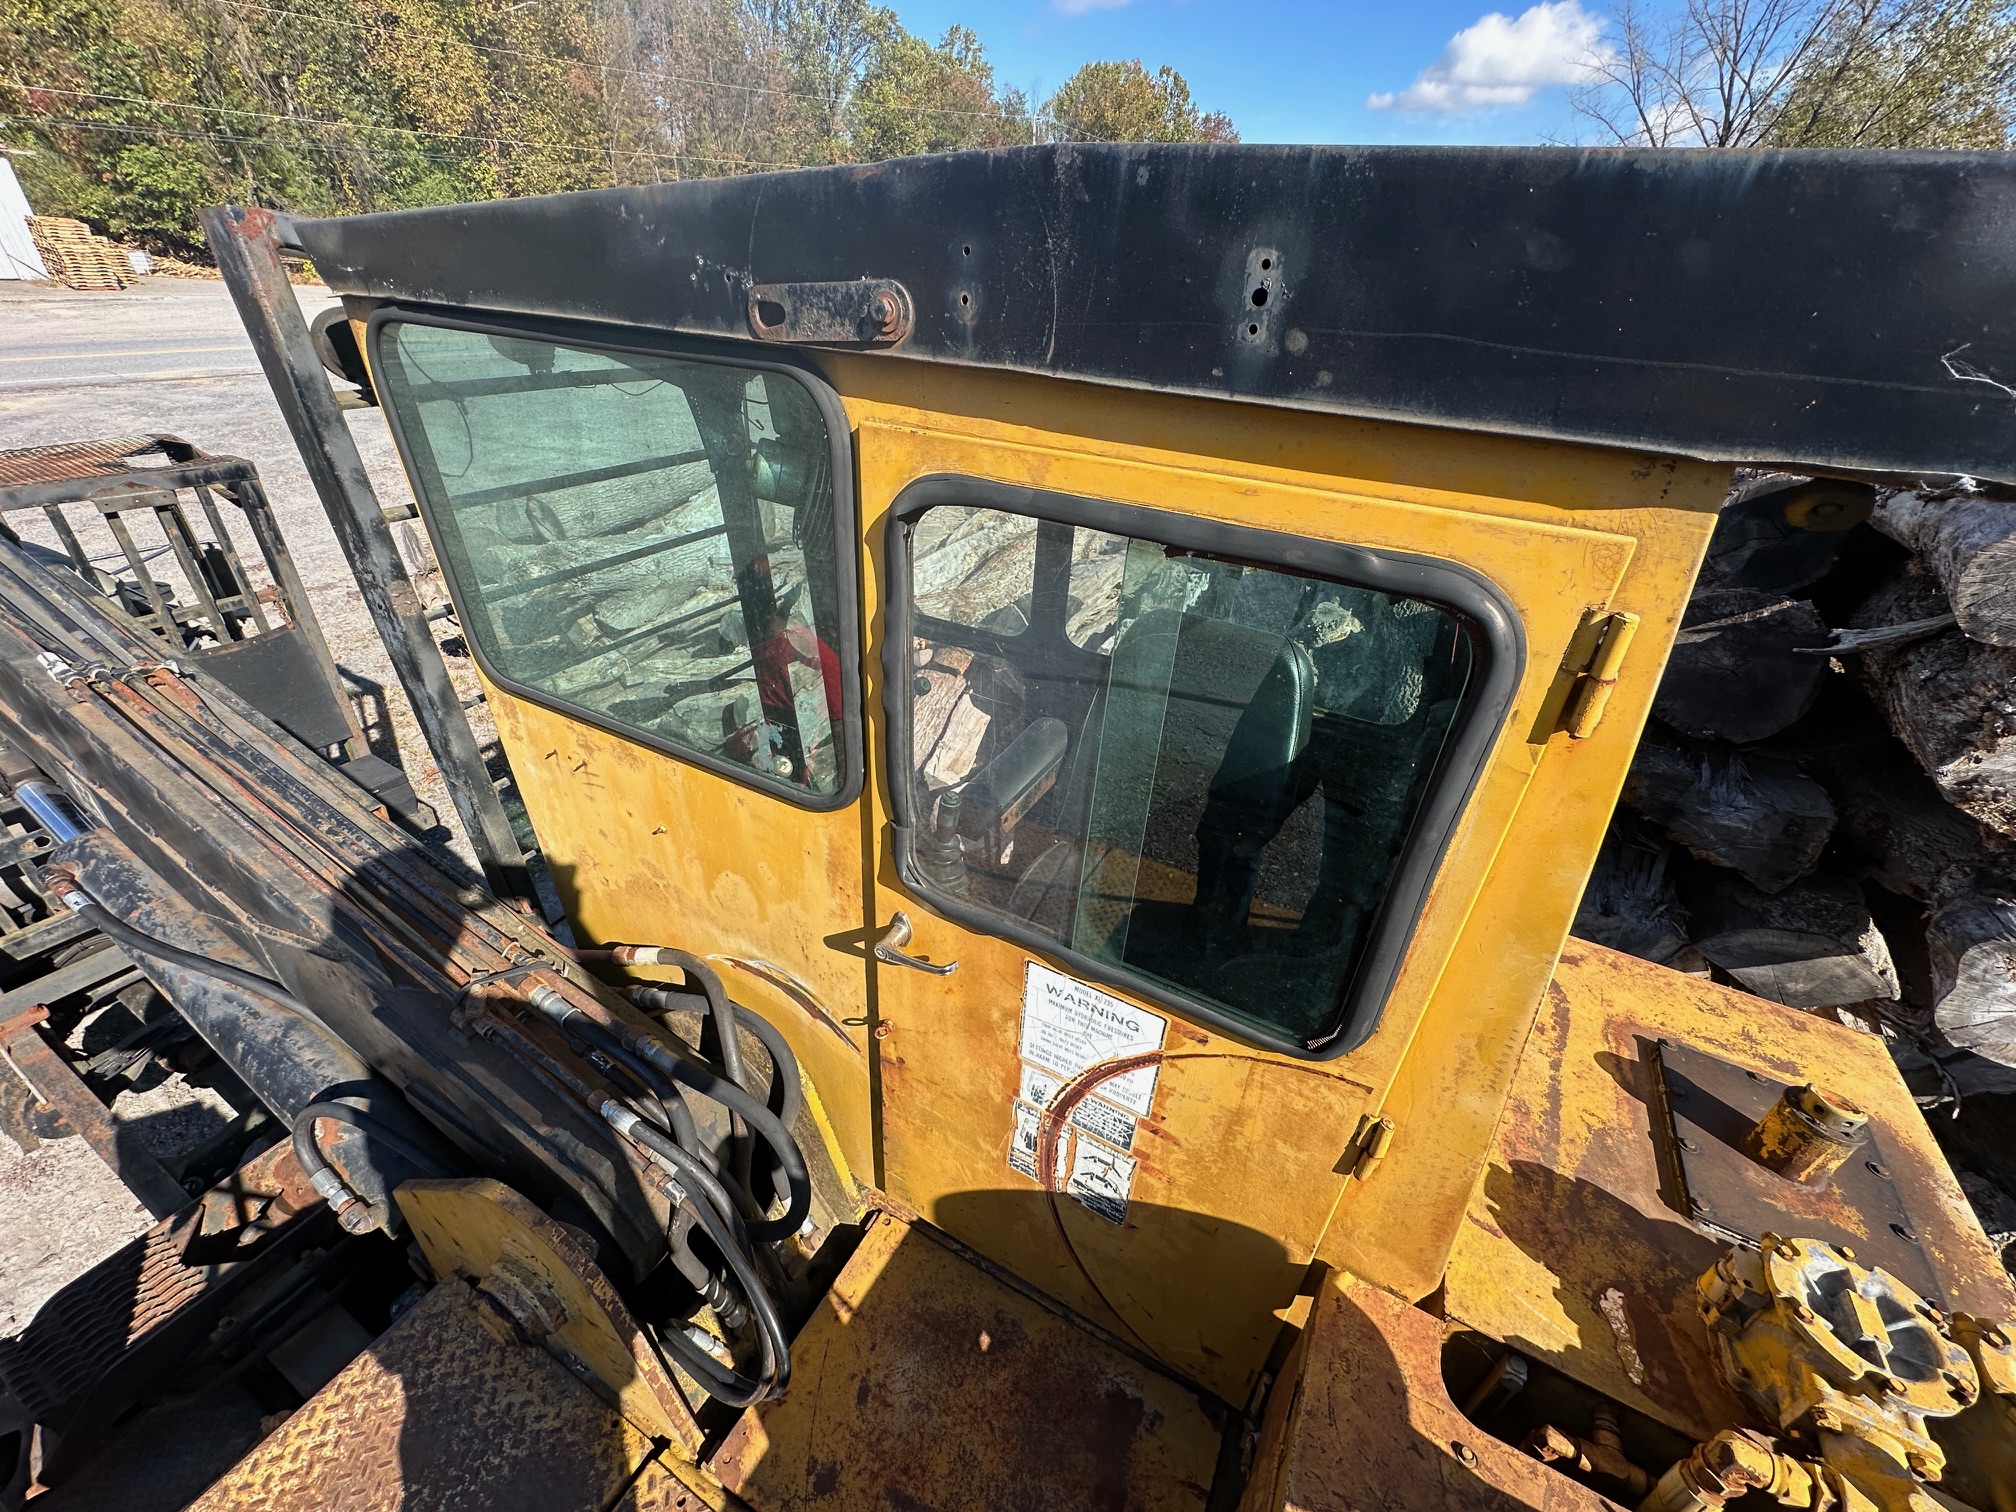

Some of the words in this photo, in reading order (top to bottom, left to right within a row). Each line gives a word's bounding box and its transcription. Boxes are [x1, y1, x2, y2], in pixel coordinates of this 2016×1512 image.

[1074, 985, 1091, 998] MODEL
[1045, 982, 1140, 1033] WARNING
[1048, 998, 1072, 1014] MAXIMUM
